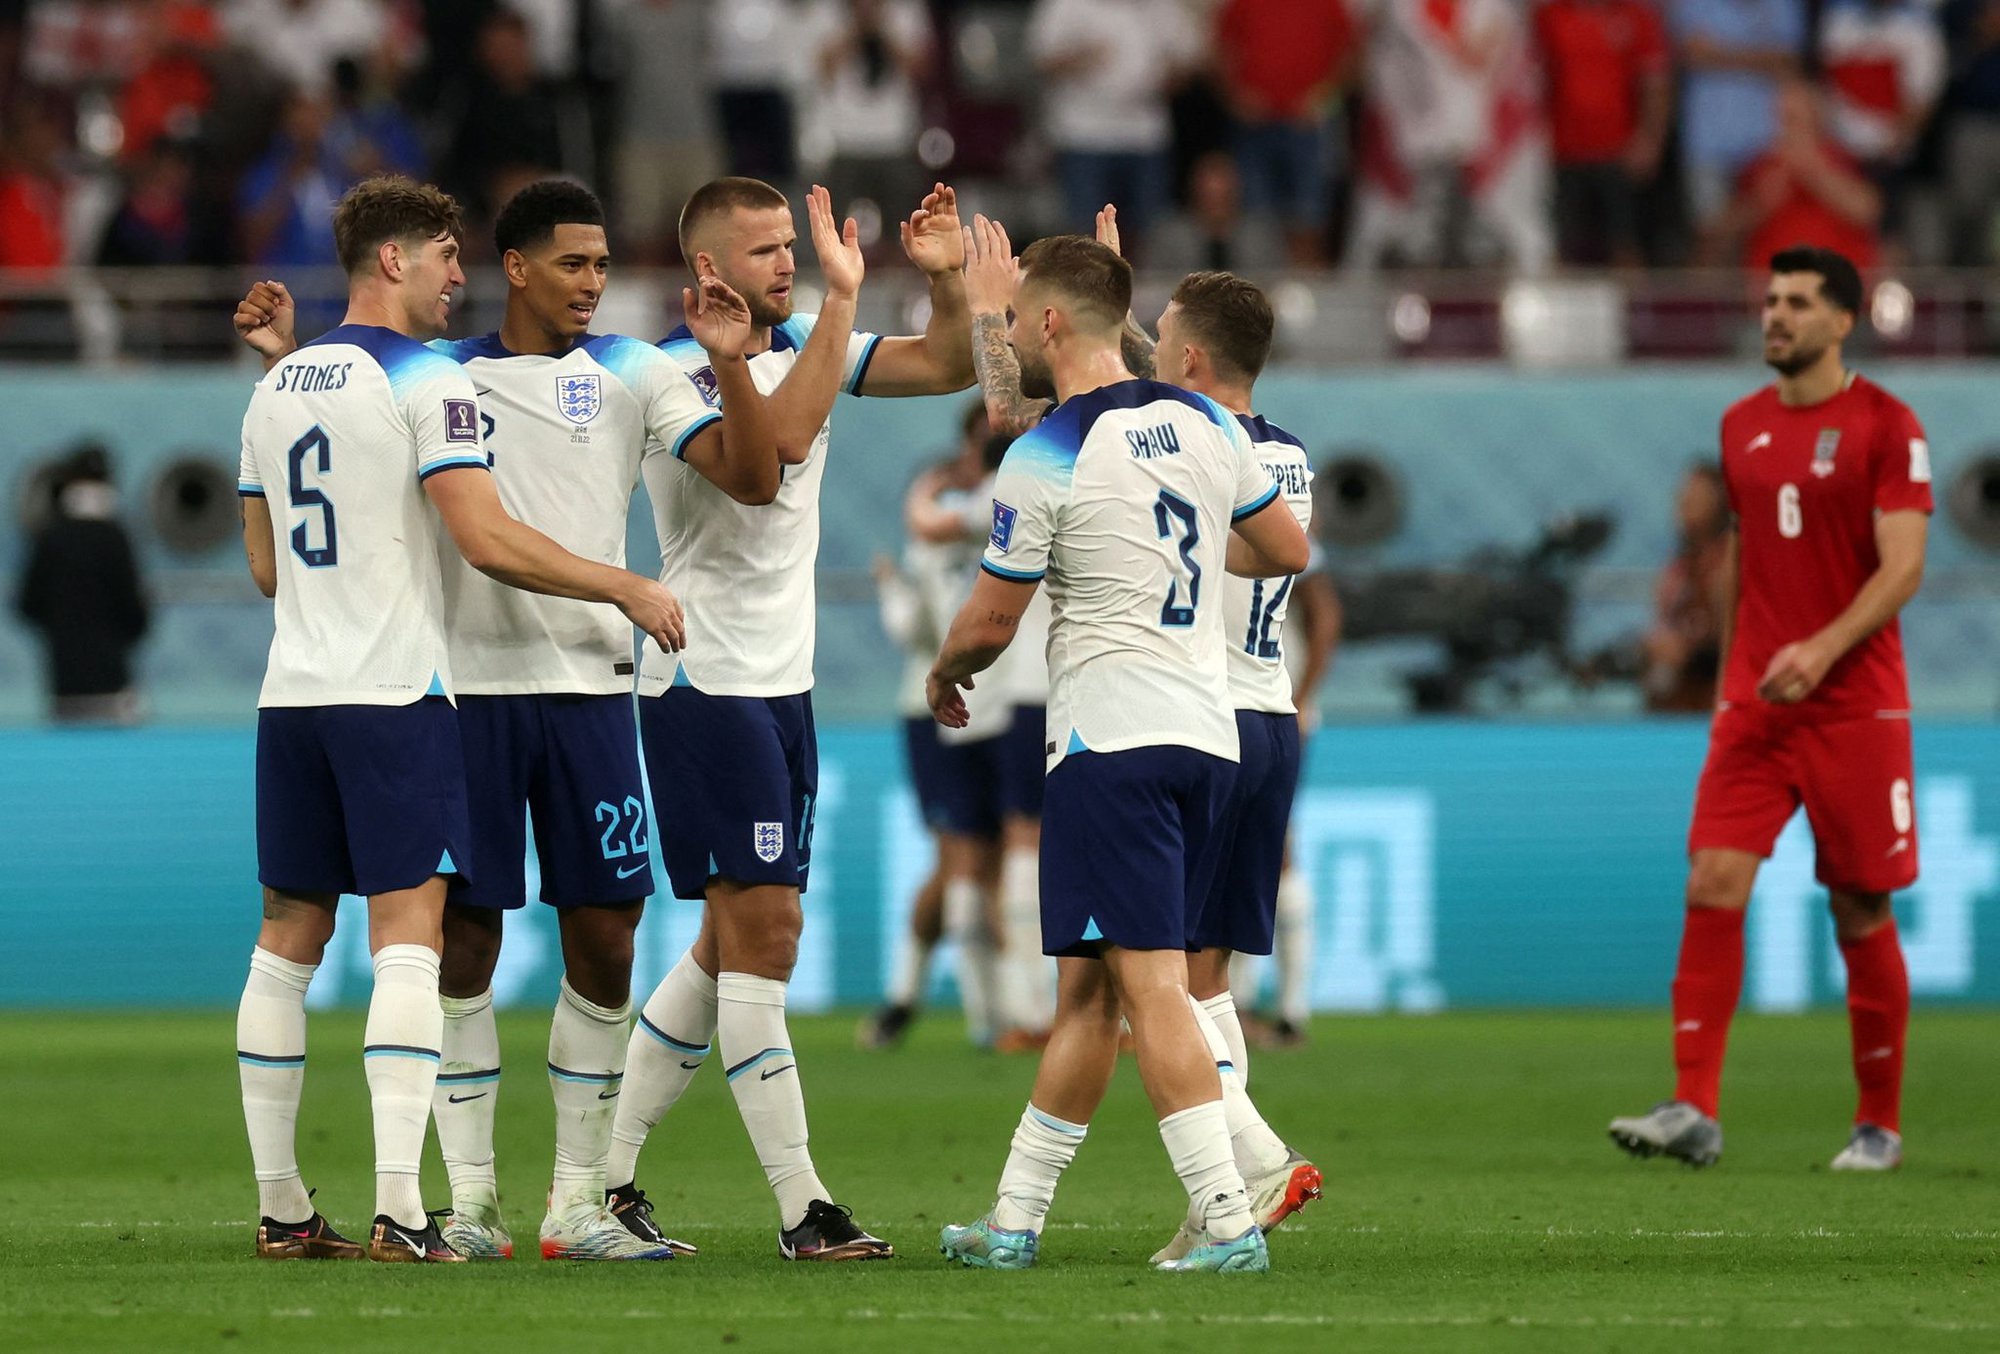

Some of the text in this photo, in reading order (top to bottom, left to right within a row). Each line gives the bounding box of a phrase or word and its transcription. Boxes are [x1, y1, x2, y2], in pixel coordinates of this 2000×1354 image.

[275, 362, 353, 392] STONES
[1125, 422, 1181, 459] SHAW
[287, 422, 338, 568] 5
[1777, 482, 1803, 539] 6
[1153, 486, 1201, 627] 3
[1244, 575, 1293, 658] 12
[595, 795, 648, 859] 22
[1889, 778, 1912, 834] 6
